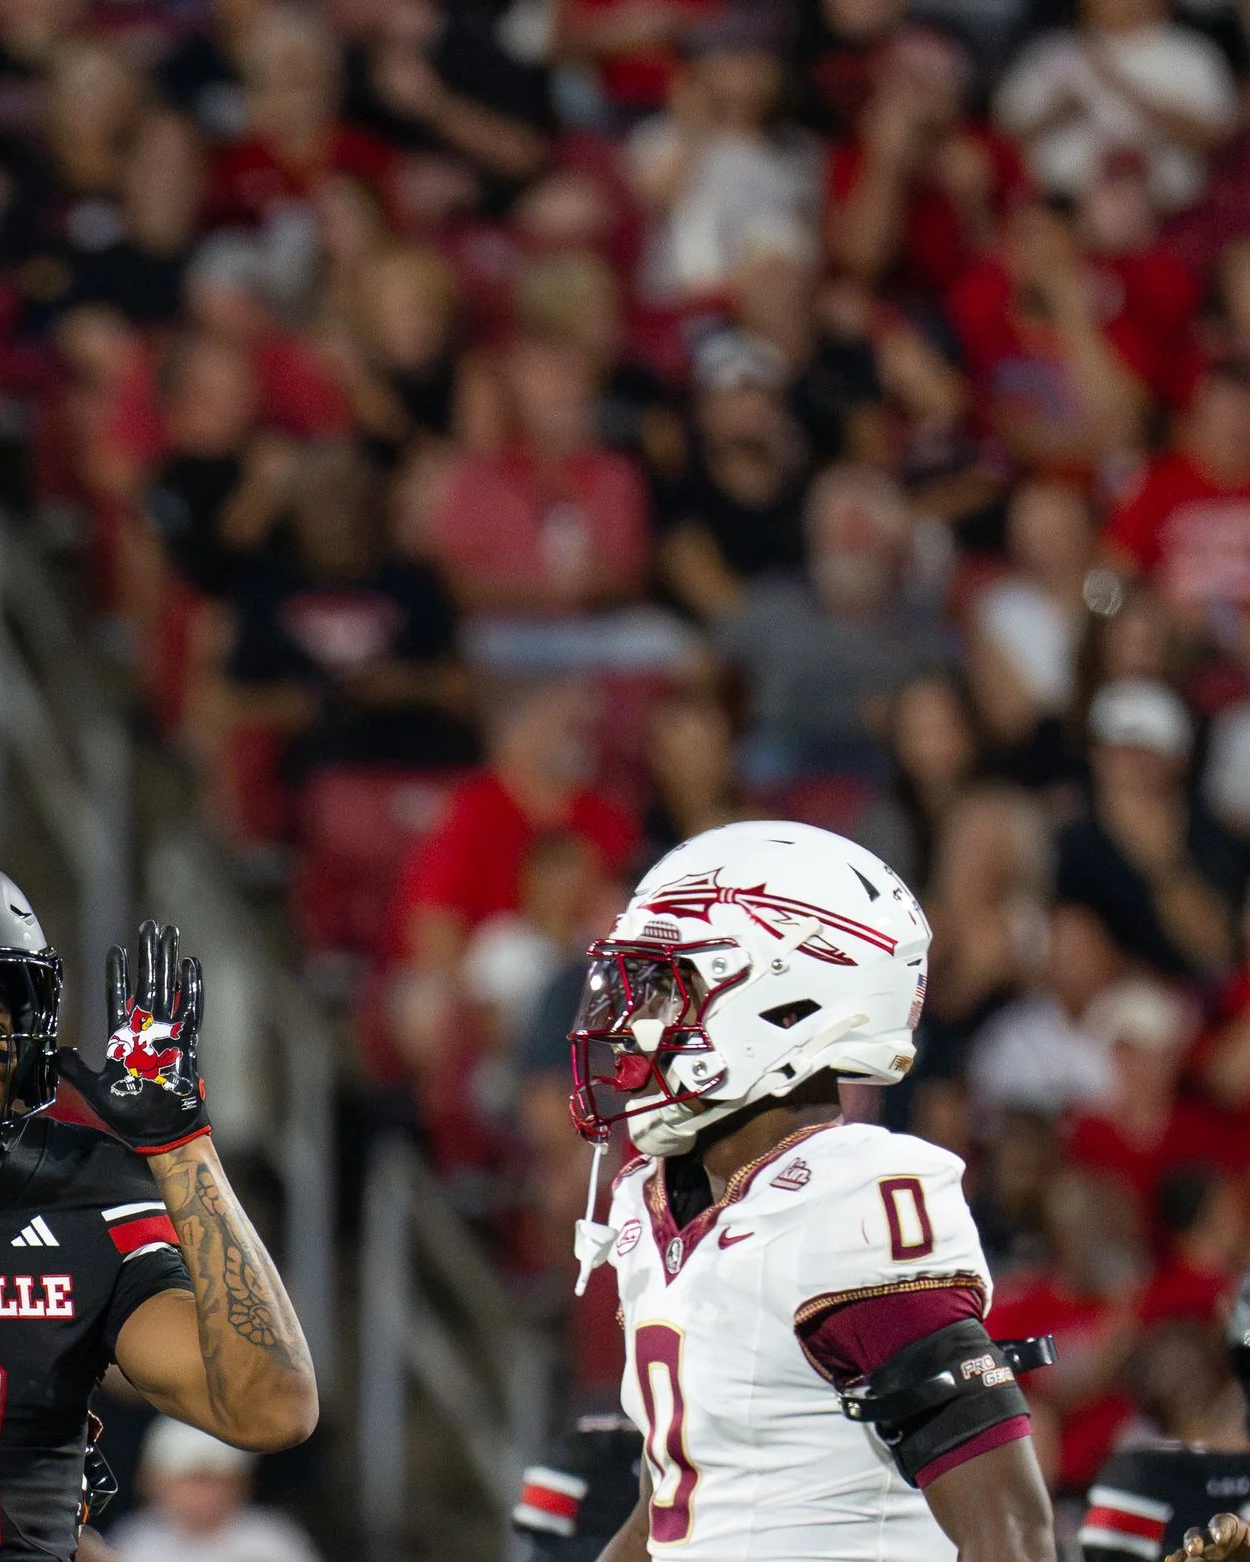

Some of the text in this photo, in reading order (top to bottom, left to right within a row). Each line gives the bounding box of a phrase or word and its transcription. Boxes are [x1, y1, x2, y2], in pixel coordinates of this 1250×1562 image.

[877, 1173, 935, 1264] 0
[960, 1354, 996, 1380] PRO
[633, 1318, 702, 1546] 0
